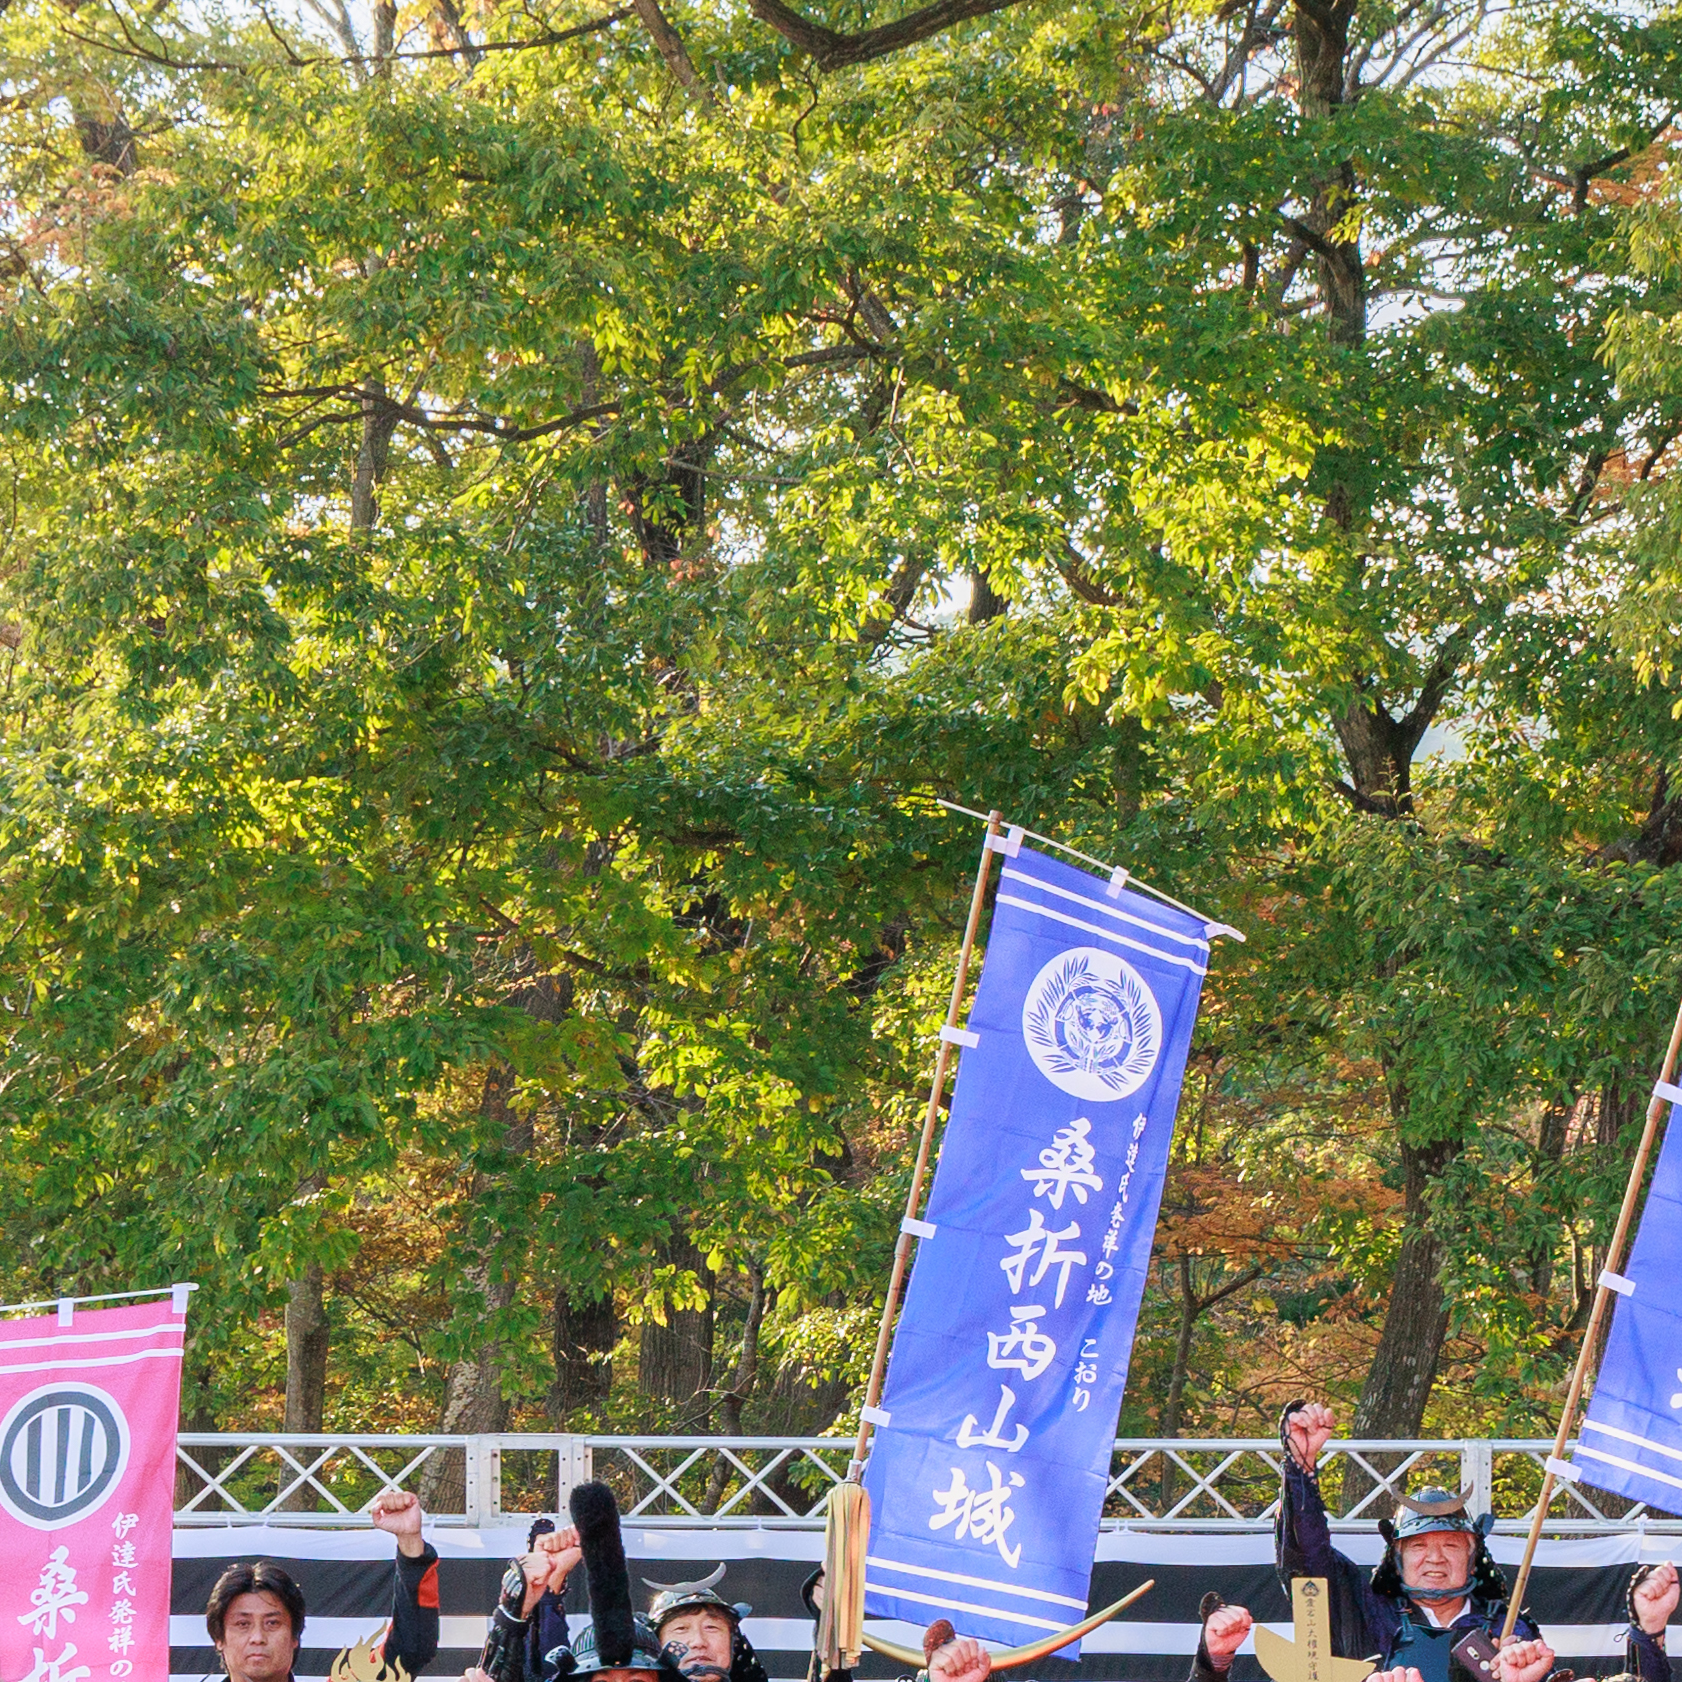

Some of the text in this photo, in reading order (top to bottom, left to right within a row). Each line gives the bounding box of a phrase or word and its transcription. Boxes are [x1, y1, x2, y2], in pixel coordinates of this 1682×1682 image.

[1085, 1111, 1149, 1307] 伊達氏発祥の地
[928, 1116, 1103, 1570] 桑折西山城
[1072, 1336, 1101, 1414] こおり
